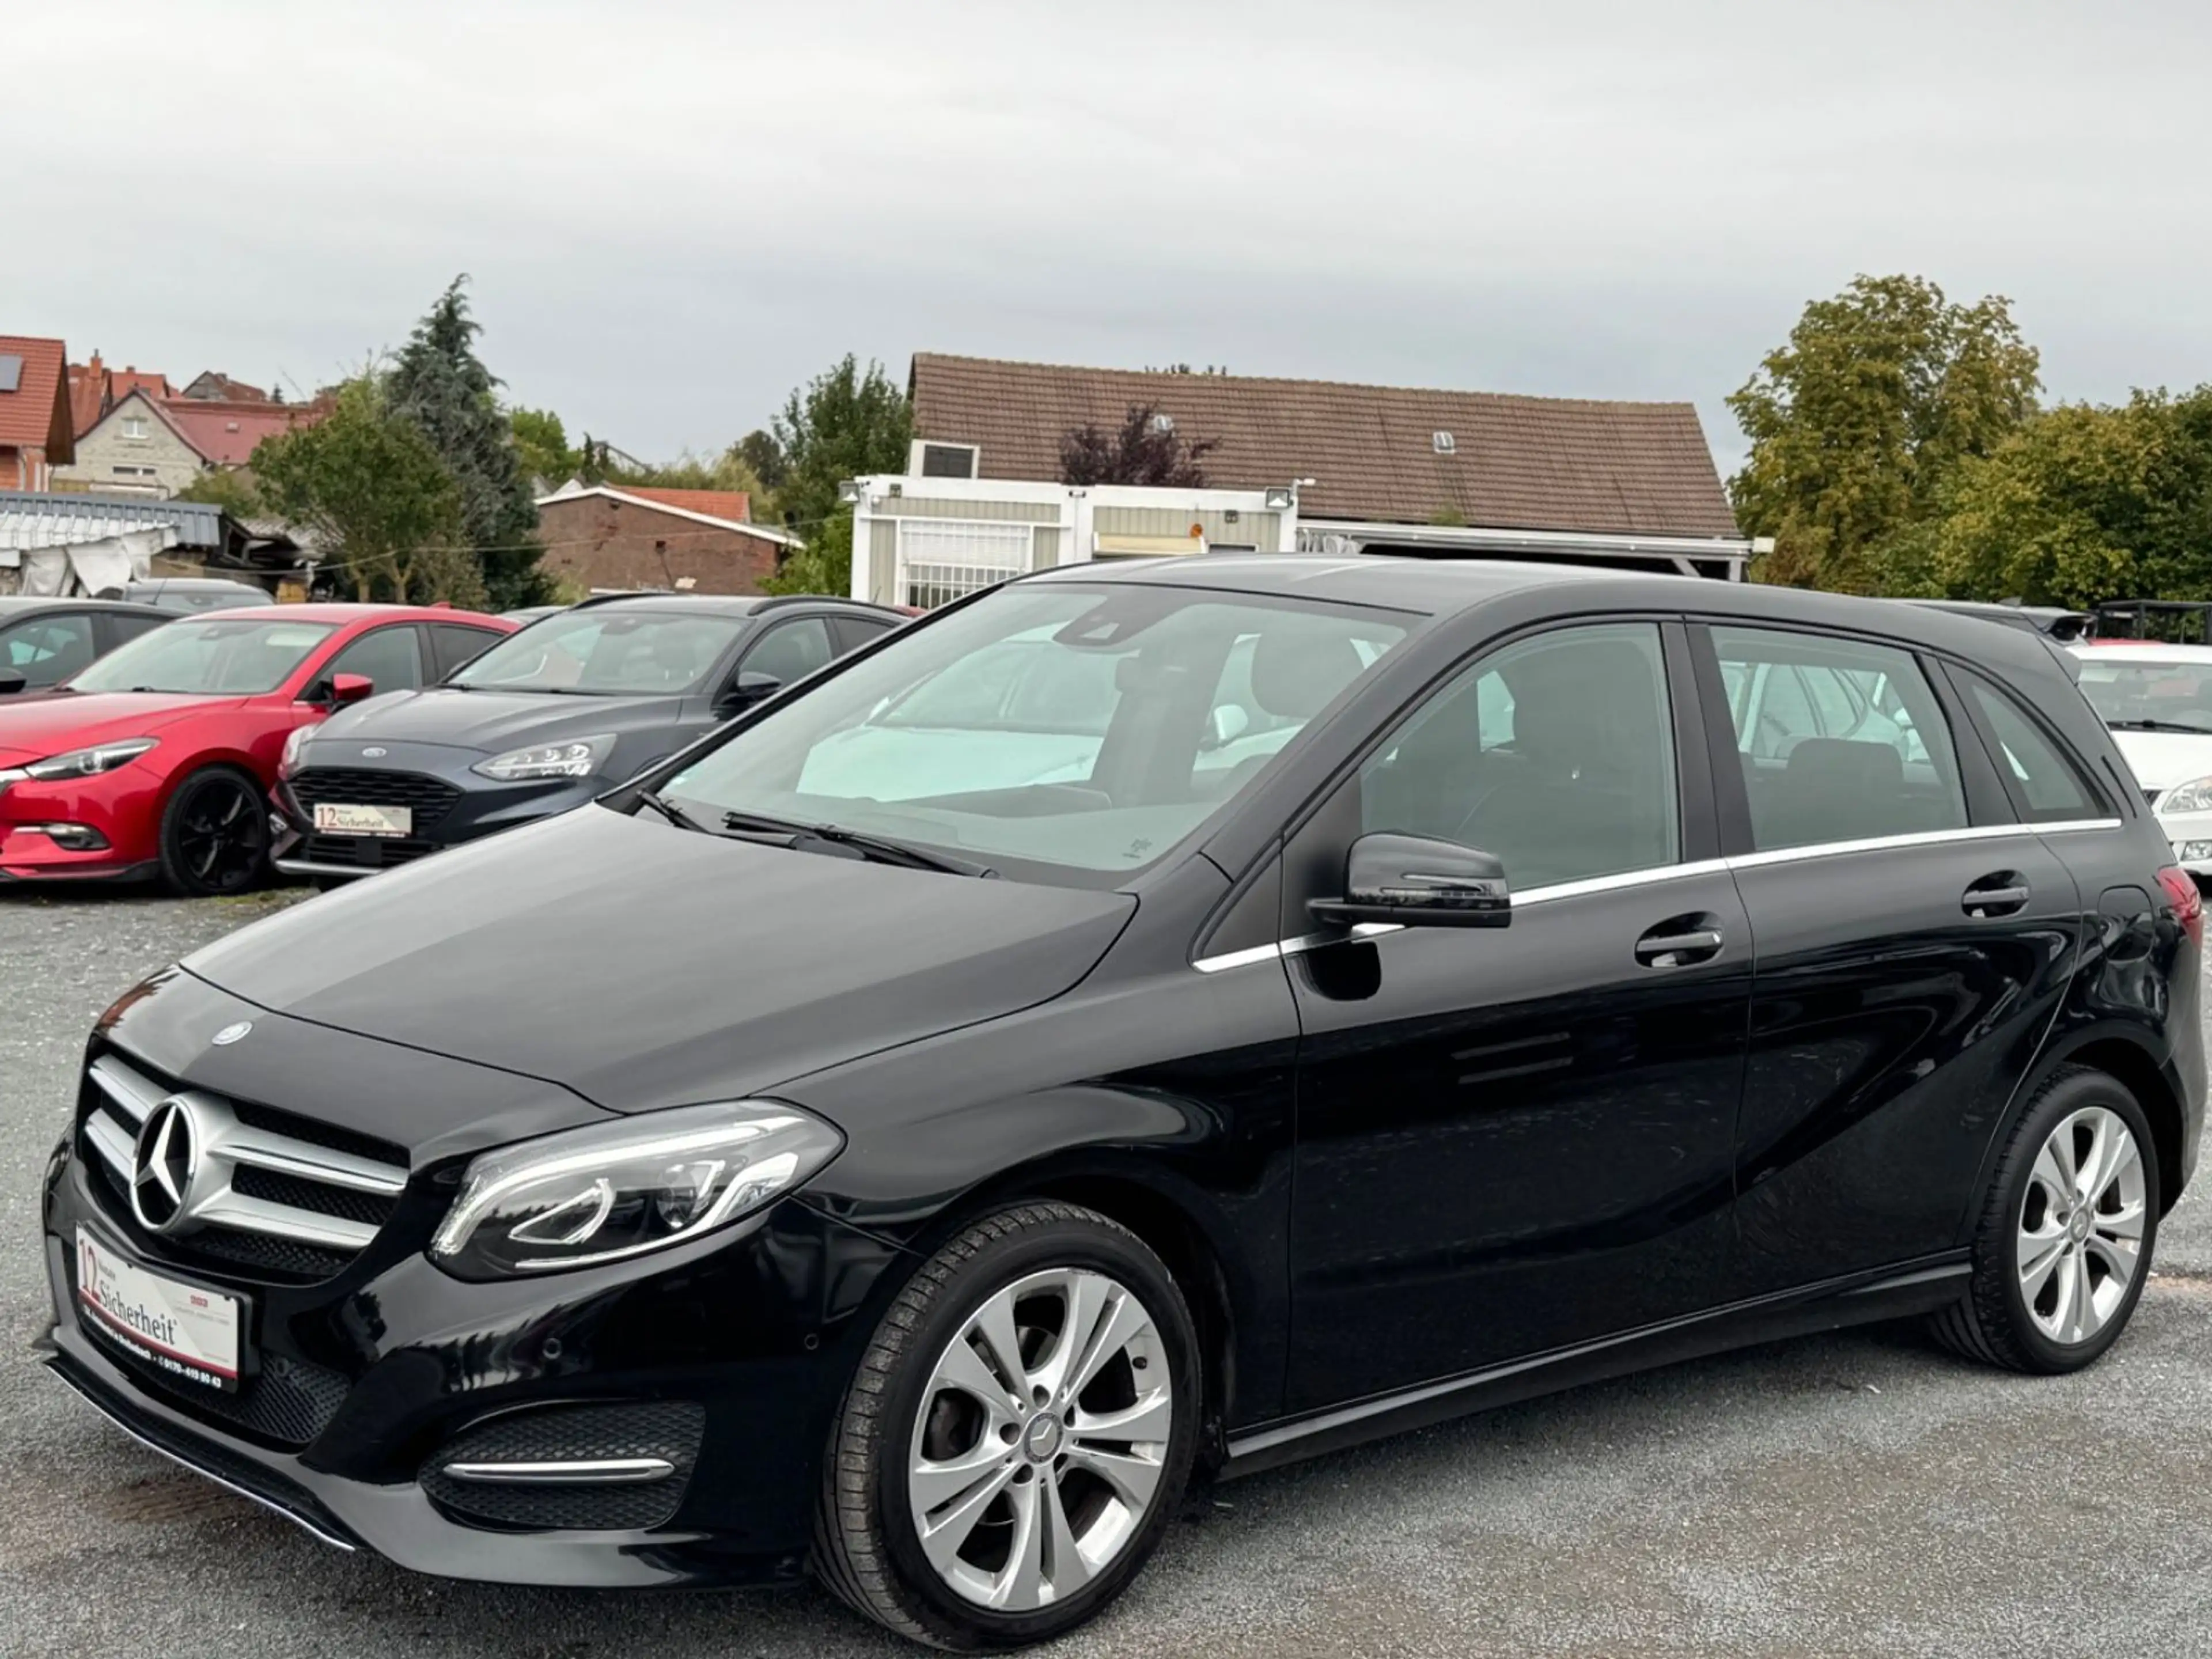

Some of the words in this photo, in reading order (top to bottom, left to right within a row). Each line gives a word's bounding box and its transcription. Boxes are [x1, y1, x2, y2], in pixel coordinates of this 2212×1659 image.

[317, 806, 337, 826] 12
[337, 816, 384, 828] Sicherheit
[79, 1238, 100, 1302] 12
[100, 1279, 175, 1345] Sicherheit
